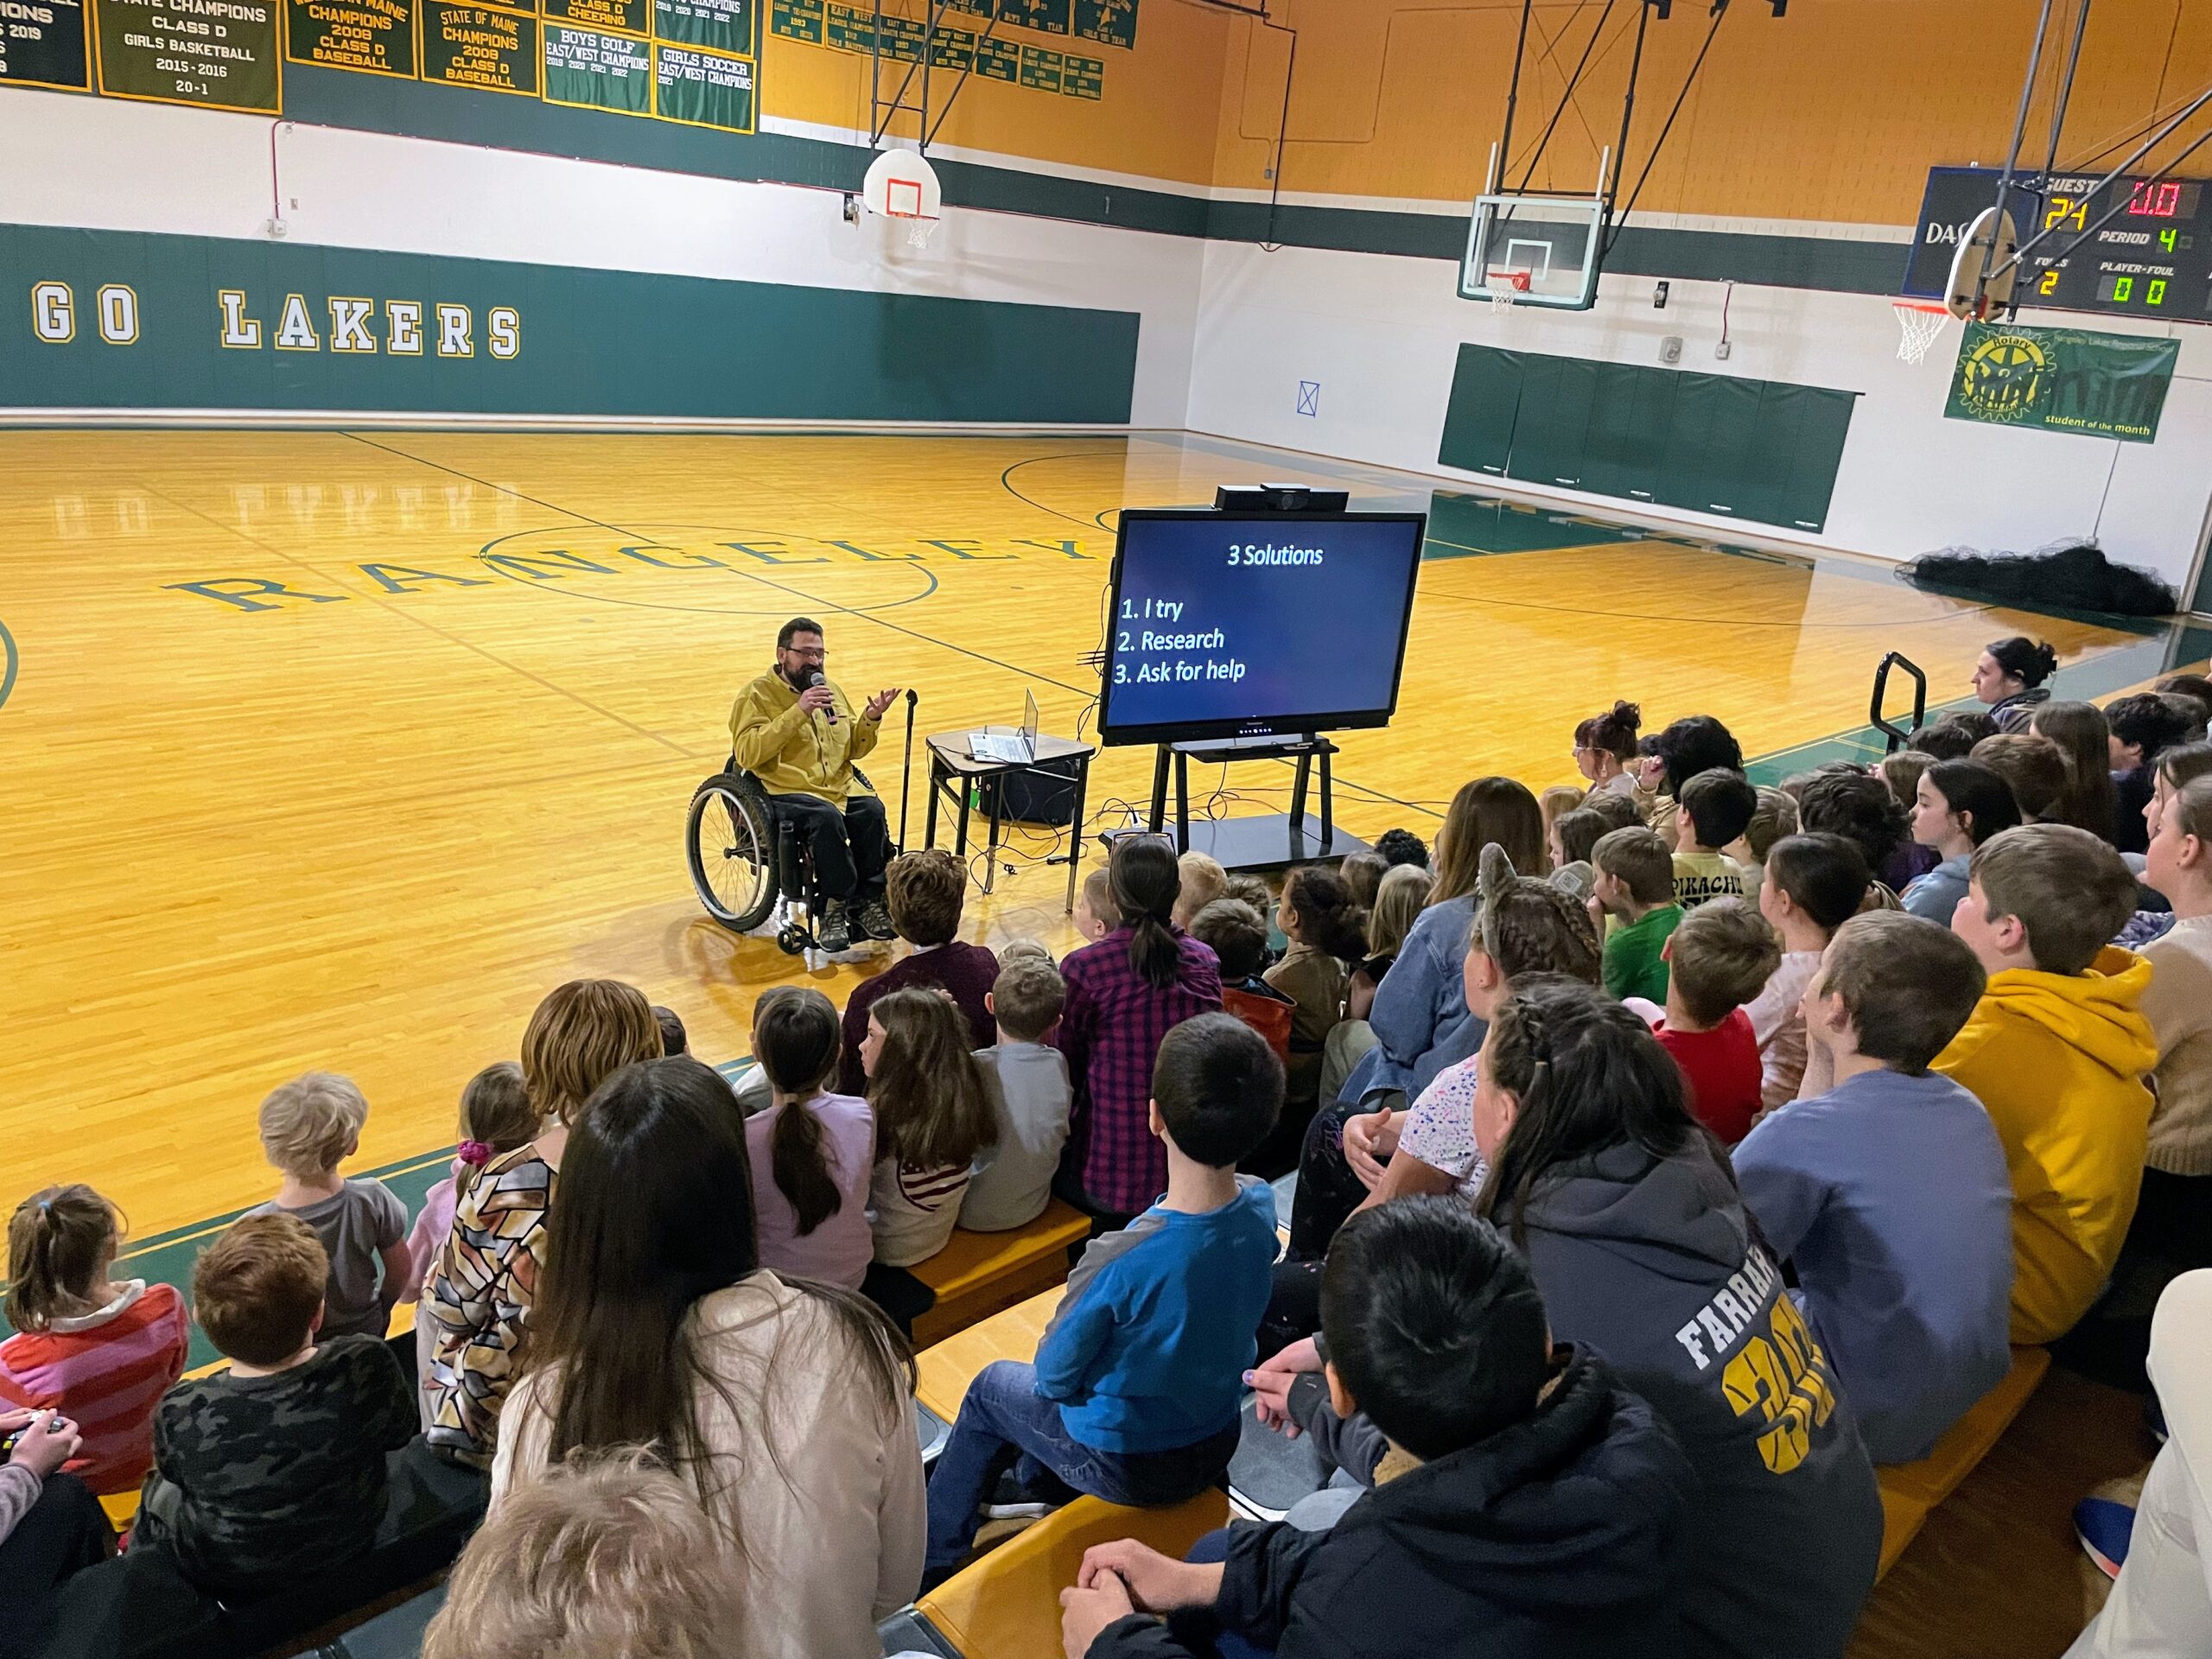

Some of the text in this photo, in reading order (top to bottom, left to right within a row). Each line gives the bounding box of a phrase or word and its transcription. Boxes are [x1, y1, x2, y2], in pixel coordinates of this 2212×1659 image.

[169, 0, 267, 22] CHAMPIONS
[308, 4, 392, 30] CHAMPIONS
[567, 7, 626, 27] CHEERING
[614, 3, 624, 16] D
[656, 1, 730, 23] 2019 2020 2021 2022
[9, 24, 42, 41] 2019
[152, 16, 227, 38] CLASS D
[331, 24, 372, 41] 2008
[440, 10, 518, 35] STATE OF MAINE
[124, 33, 256, 62] GIRLS BASKETBALL
[320, 35, 385, 55] CLASS D
[442, 27, 518, 51] CHAMPIONS
[560, 29, 635, 54] BOYS GOLF
[313, 48, 391, 70] BASEBALL
[462, 45, 499, 60] 2008
[546, 41, 649, 72] EAST/WEST CHAMPIONS
[663, 48, 748, 77] GIRLS SOCCER
[452, 56, 510, 75] CLASS D
[546, 56, 628, 79] 2019 2020 2021 2022
[658, 61, 753, 91] EAST/WEST CHAMPIONS
[175, 79, 208, 95] 20-1
[446, 67, 516, 88] BASEBALL
[2099, 228, 2177, 253] PERIOD 4
[2100, 261, 2174, 276] PLAYER-FOUL
[2040, 271, 2058, 296] 2
[2113, 276, 2167, 305] 0 0
[32, 281, 520, 360] GO LAKERS
[1993, 335, 2031, 350] Rotary
[2044, 414, 2151, 436] student of the month
[1228, 543, 1324, 566] 3 Solutions
[162, 537, 1098, 613] RANGELEY
[1122, 598, 1184, 622] 1. I try
[1117, 627, 1224, 652] 2. Research
[1113, 658, 1246, 684] 3. Ask for help
